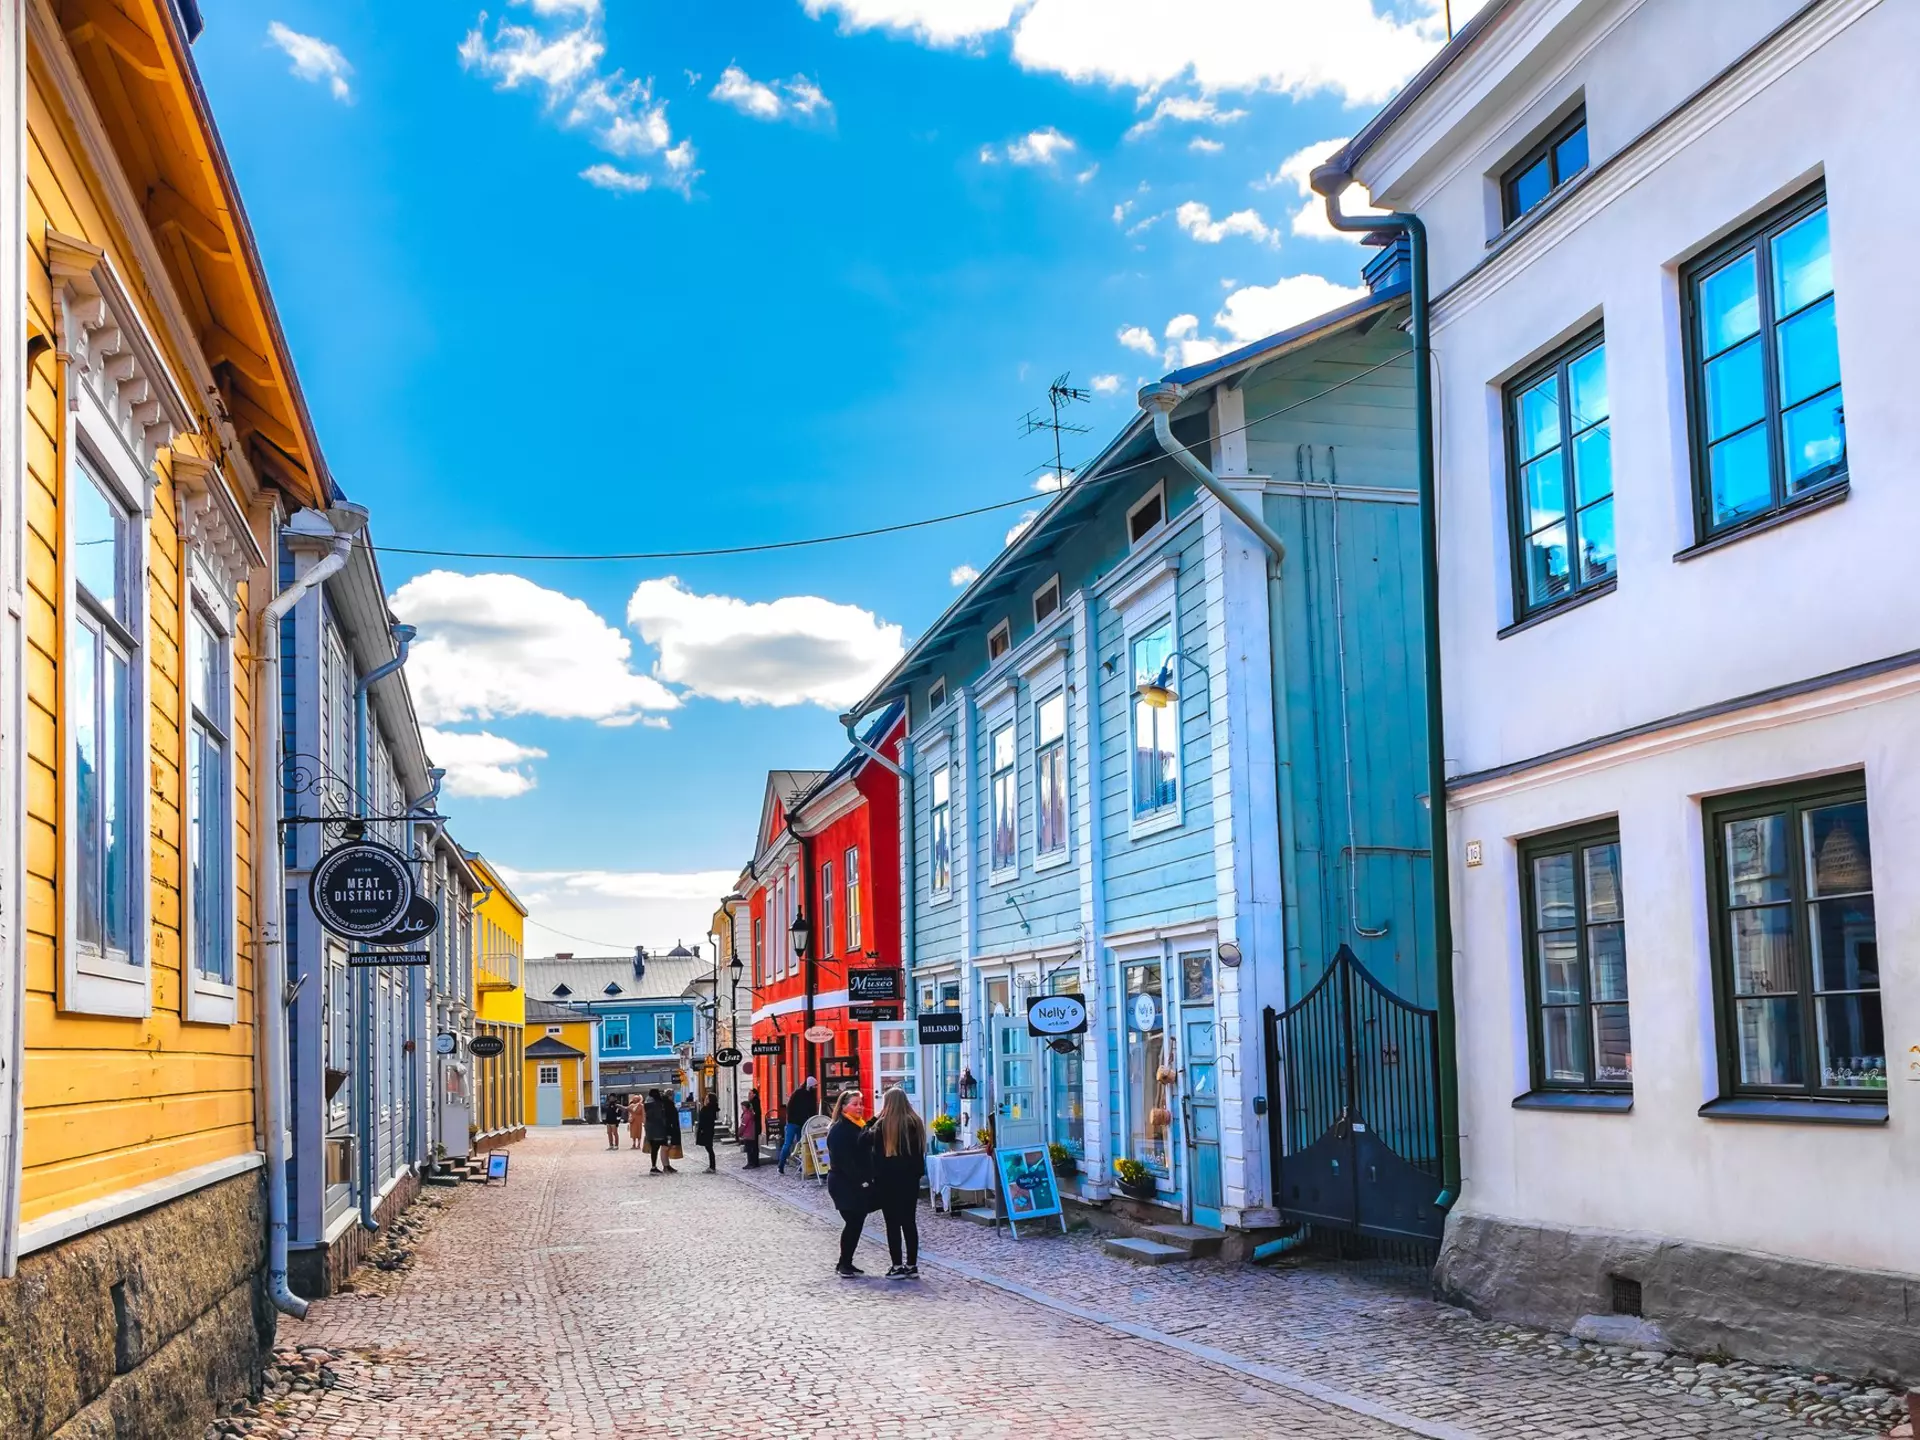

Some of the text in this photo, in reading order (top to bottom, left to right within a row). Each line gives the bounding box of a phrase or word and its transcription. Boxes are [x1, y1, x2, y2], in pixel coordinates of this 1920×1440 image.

[347, 877, 380, 889] MEAT
[334, 890, 393, 902] DISTRICT
[351, 954, 427, 964] HOTEL & WINEBAR
[850, 976, 893, 990] Museo
[922, 1024, 960, 1033] BILD&BO
